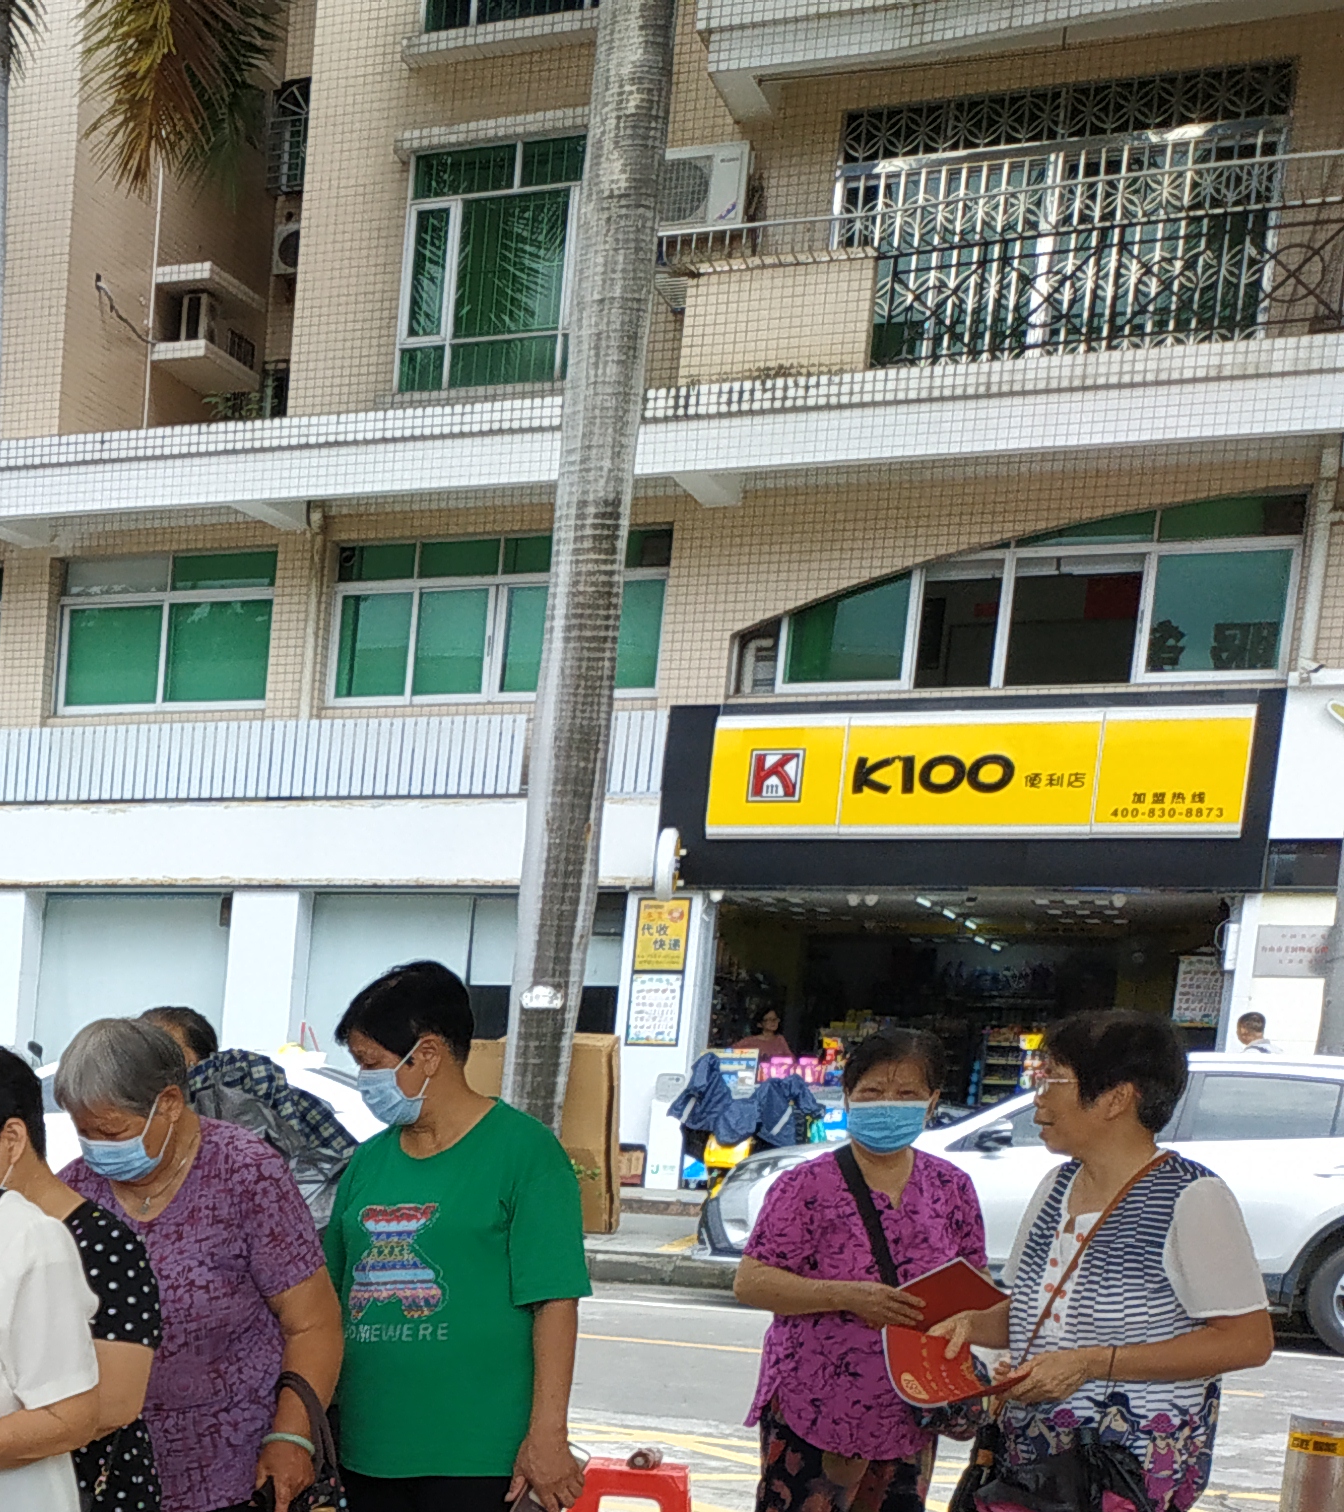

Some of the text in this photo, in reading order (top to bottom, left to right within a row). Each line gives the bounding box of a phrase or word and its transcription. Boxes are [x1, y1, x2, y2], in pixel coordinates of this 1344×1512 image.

[852, 754, 1086, 795] K100 便利店
[1131, 791, 1206, 805] 加盟热线
[1110, 807, 1224, 819] 400-830-8873
